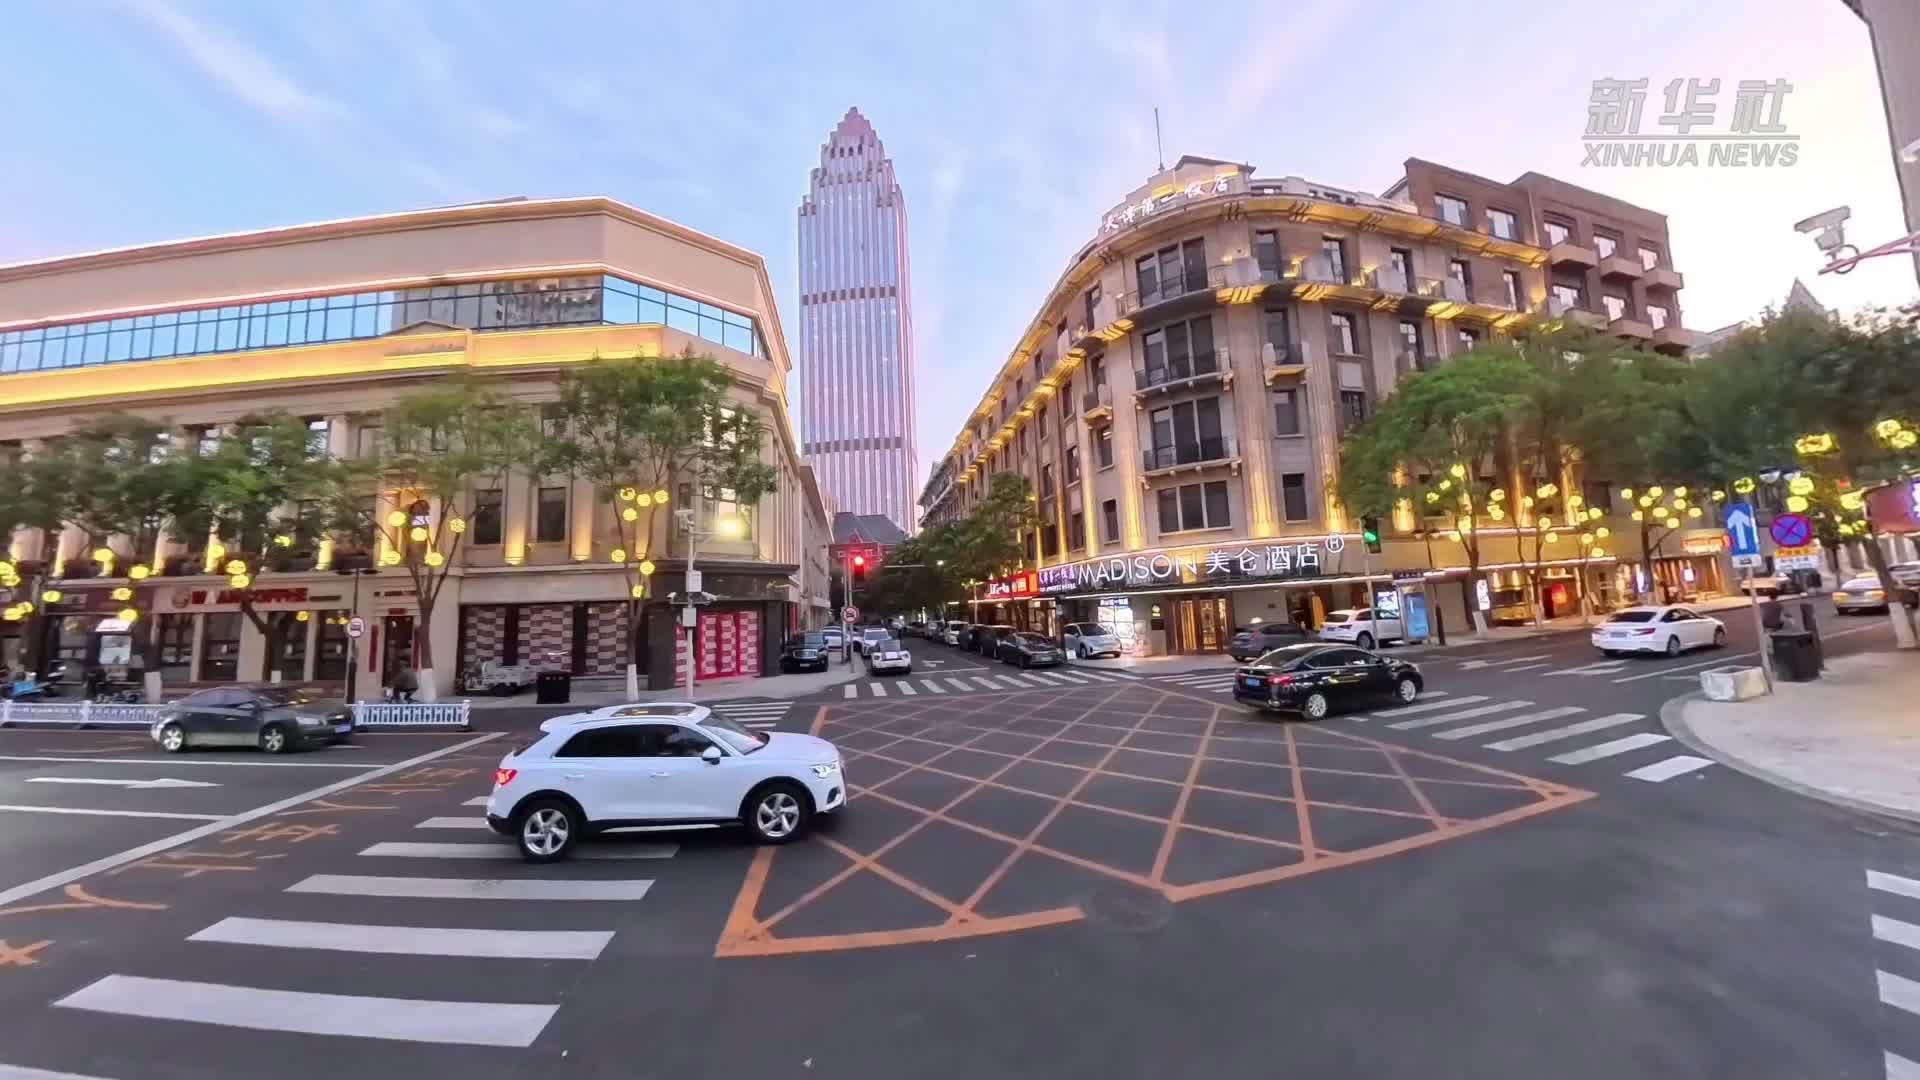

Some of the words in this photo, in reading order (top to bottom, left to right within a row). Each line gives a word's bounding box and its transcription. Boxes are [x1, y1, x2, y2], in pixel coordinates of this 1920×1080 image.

[1078, 555, 1198, 585] MADISON
[1206, 542, 1319, 574] 美仑酒店
